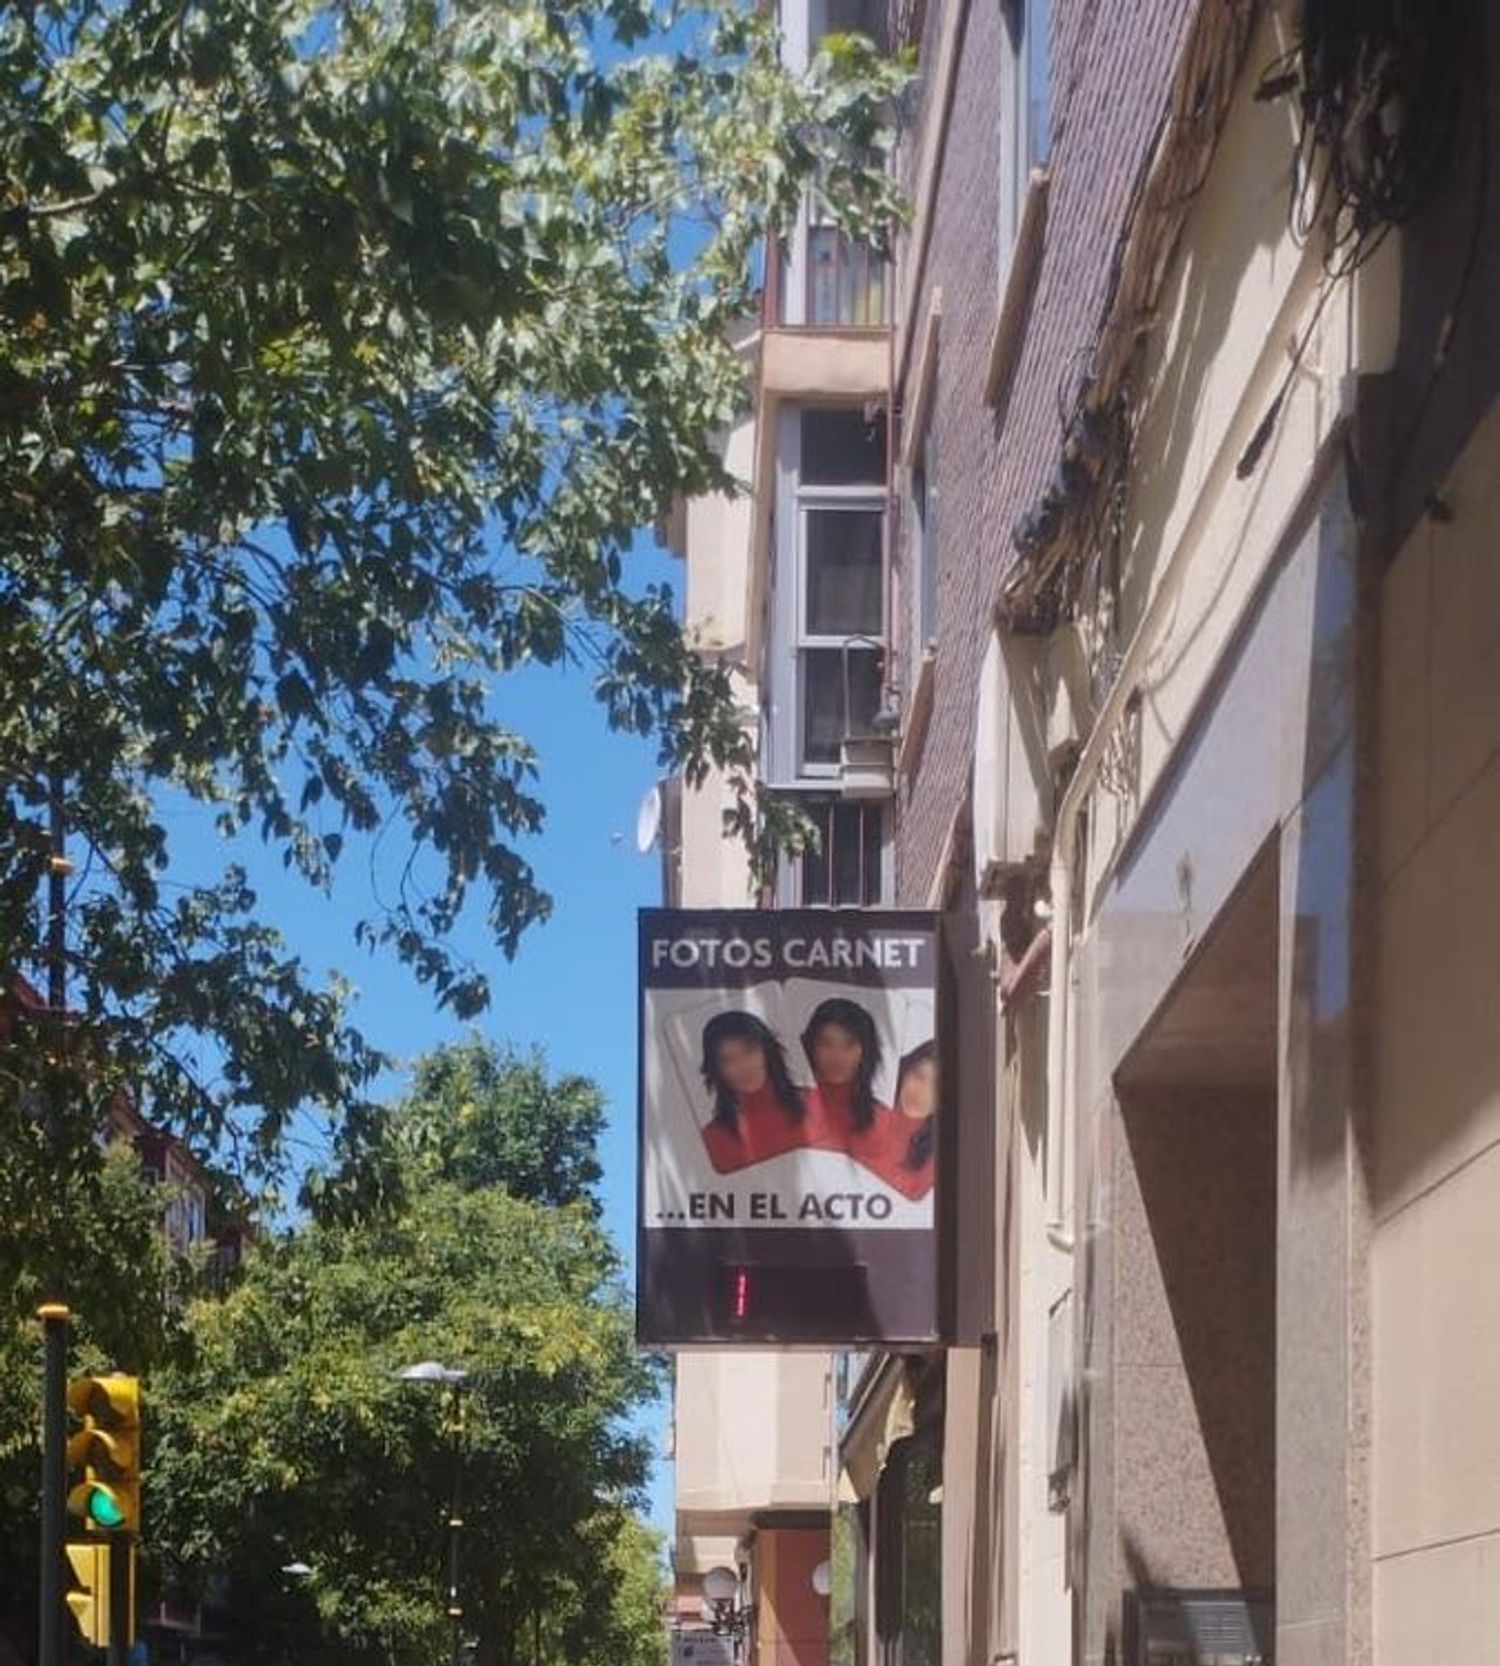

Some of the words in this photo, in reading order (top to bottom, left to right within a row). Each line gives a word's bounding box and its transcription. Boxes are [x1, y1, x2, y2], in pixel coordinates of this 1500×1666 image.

[652, 938, 772, 968] FOTOS
[782, 938, 925, 968] CARNET
[749, 1192, 787, 1220] EL
[799, 1192, 892, 1220] ACTO
